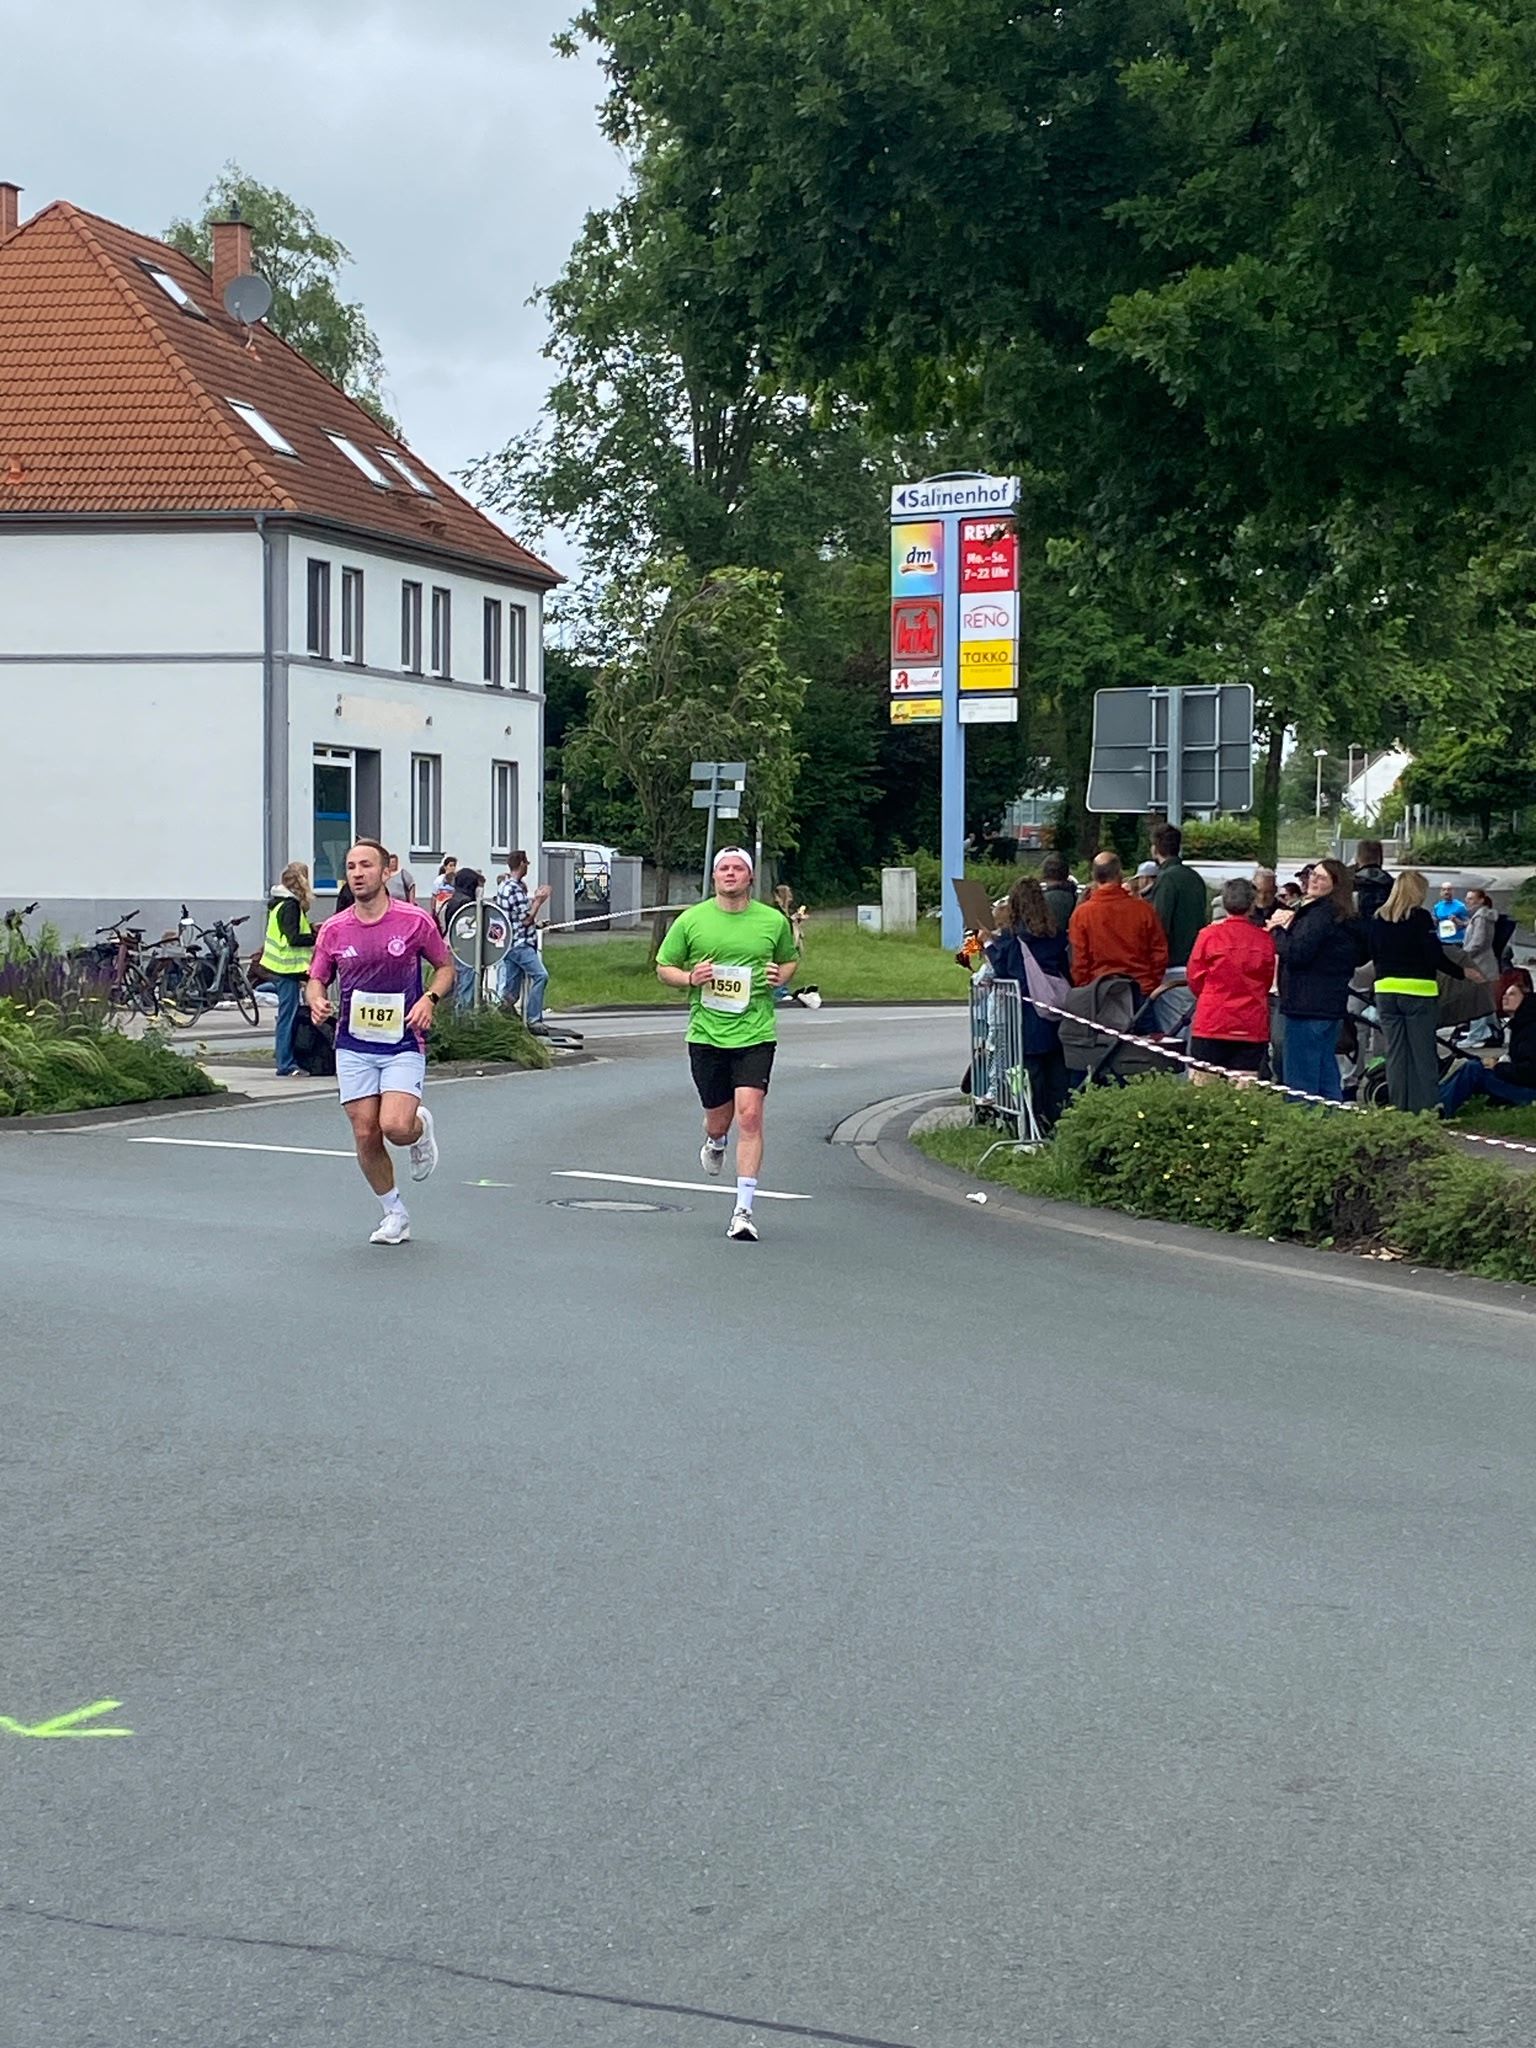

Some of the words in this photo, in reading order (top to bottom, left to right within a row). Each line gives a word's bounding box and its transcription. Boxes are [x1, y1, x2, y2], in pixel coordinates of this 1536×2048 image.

[908, 483, 1009, 507] Salinenhof
[964, 523, 1010, 541] REW
[906, 546, 932, 564] dm
[991, 566, 1010, 578] Uhr
[964, 611, 1010, 629] RENO
[360, 1007, 394, 1021] 1187
